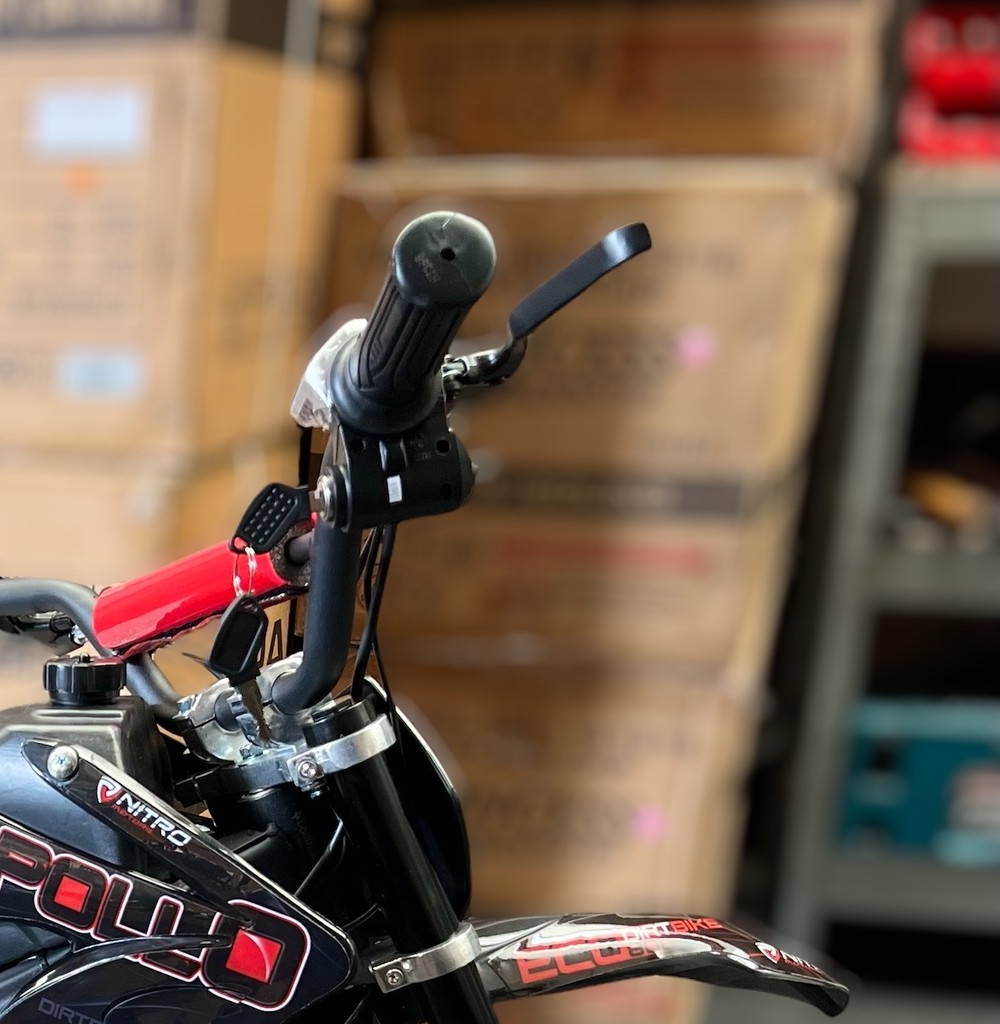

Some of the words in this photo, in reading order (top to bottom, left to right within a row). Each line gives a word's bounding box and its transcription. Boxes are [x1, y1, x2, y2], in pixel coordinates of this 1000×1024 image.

[115, 792, 192, 847] NITRO
[515, 934, 632, 985] ECO
[620, 916, 723, 942] DIRTBIKE
